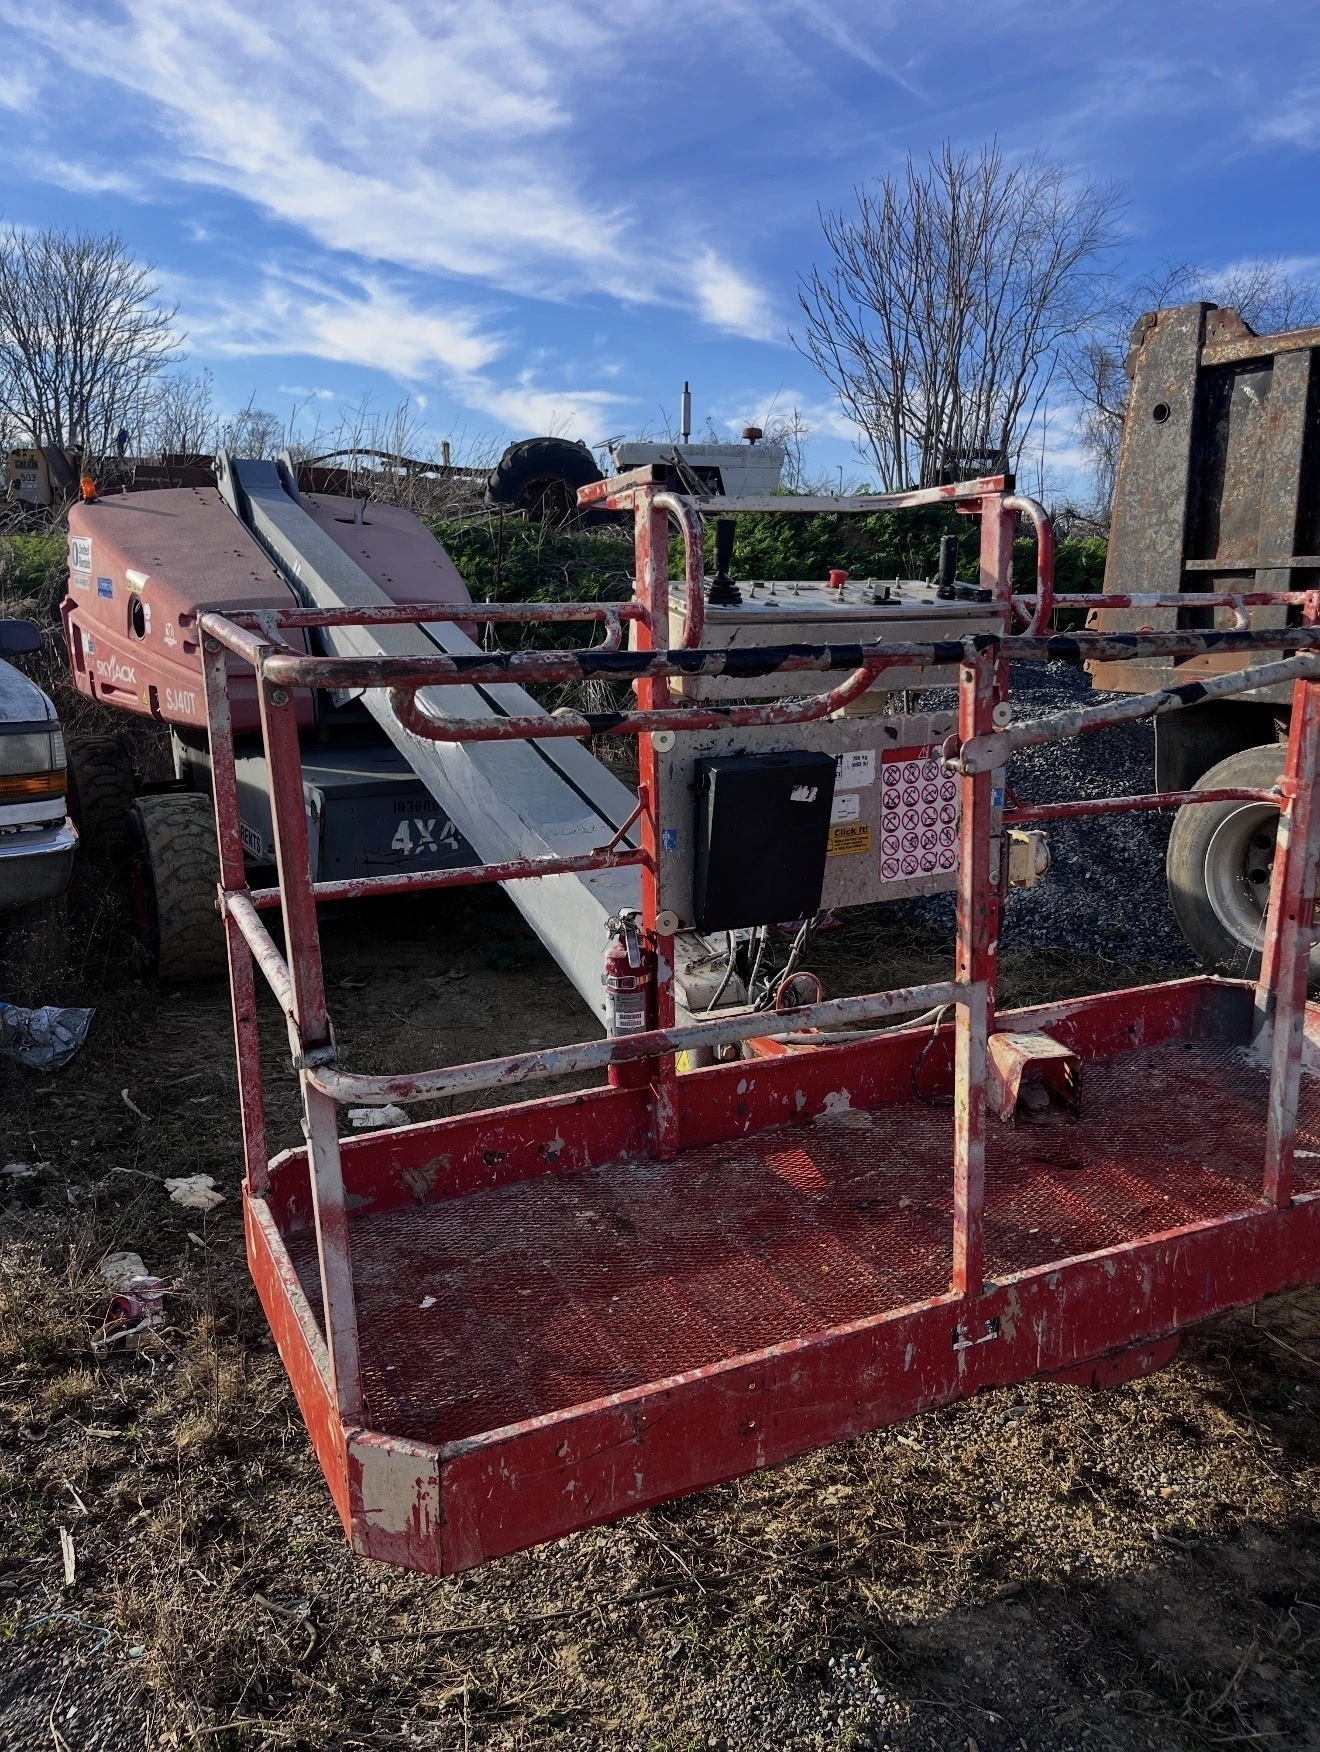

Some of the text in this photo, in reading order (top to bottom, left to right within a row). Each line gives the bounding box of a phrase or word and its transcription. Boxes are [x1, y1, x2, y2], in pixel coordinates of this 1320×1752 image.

[97, 655, 136, 683] SKYJACK
[166, 688, 195, 714] SJ40T
[834, 825, 868, 837] Click It!
